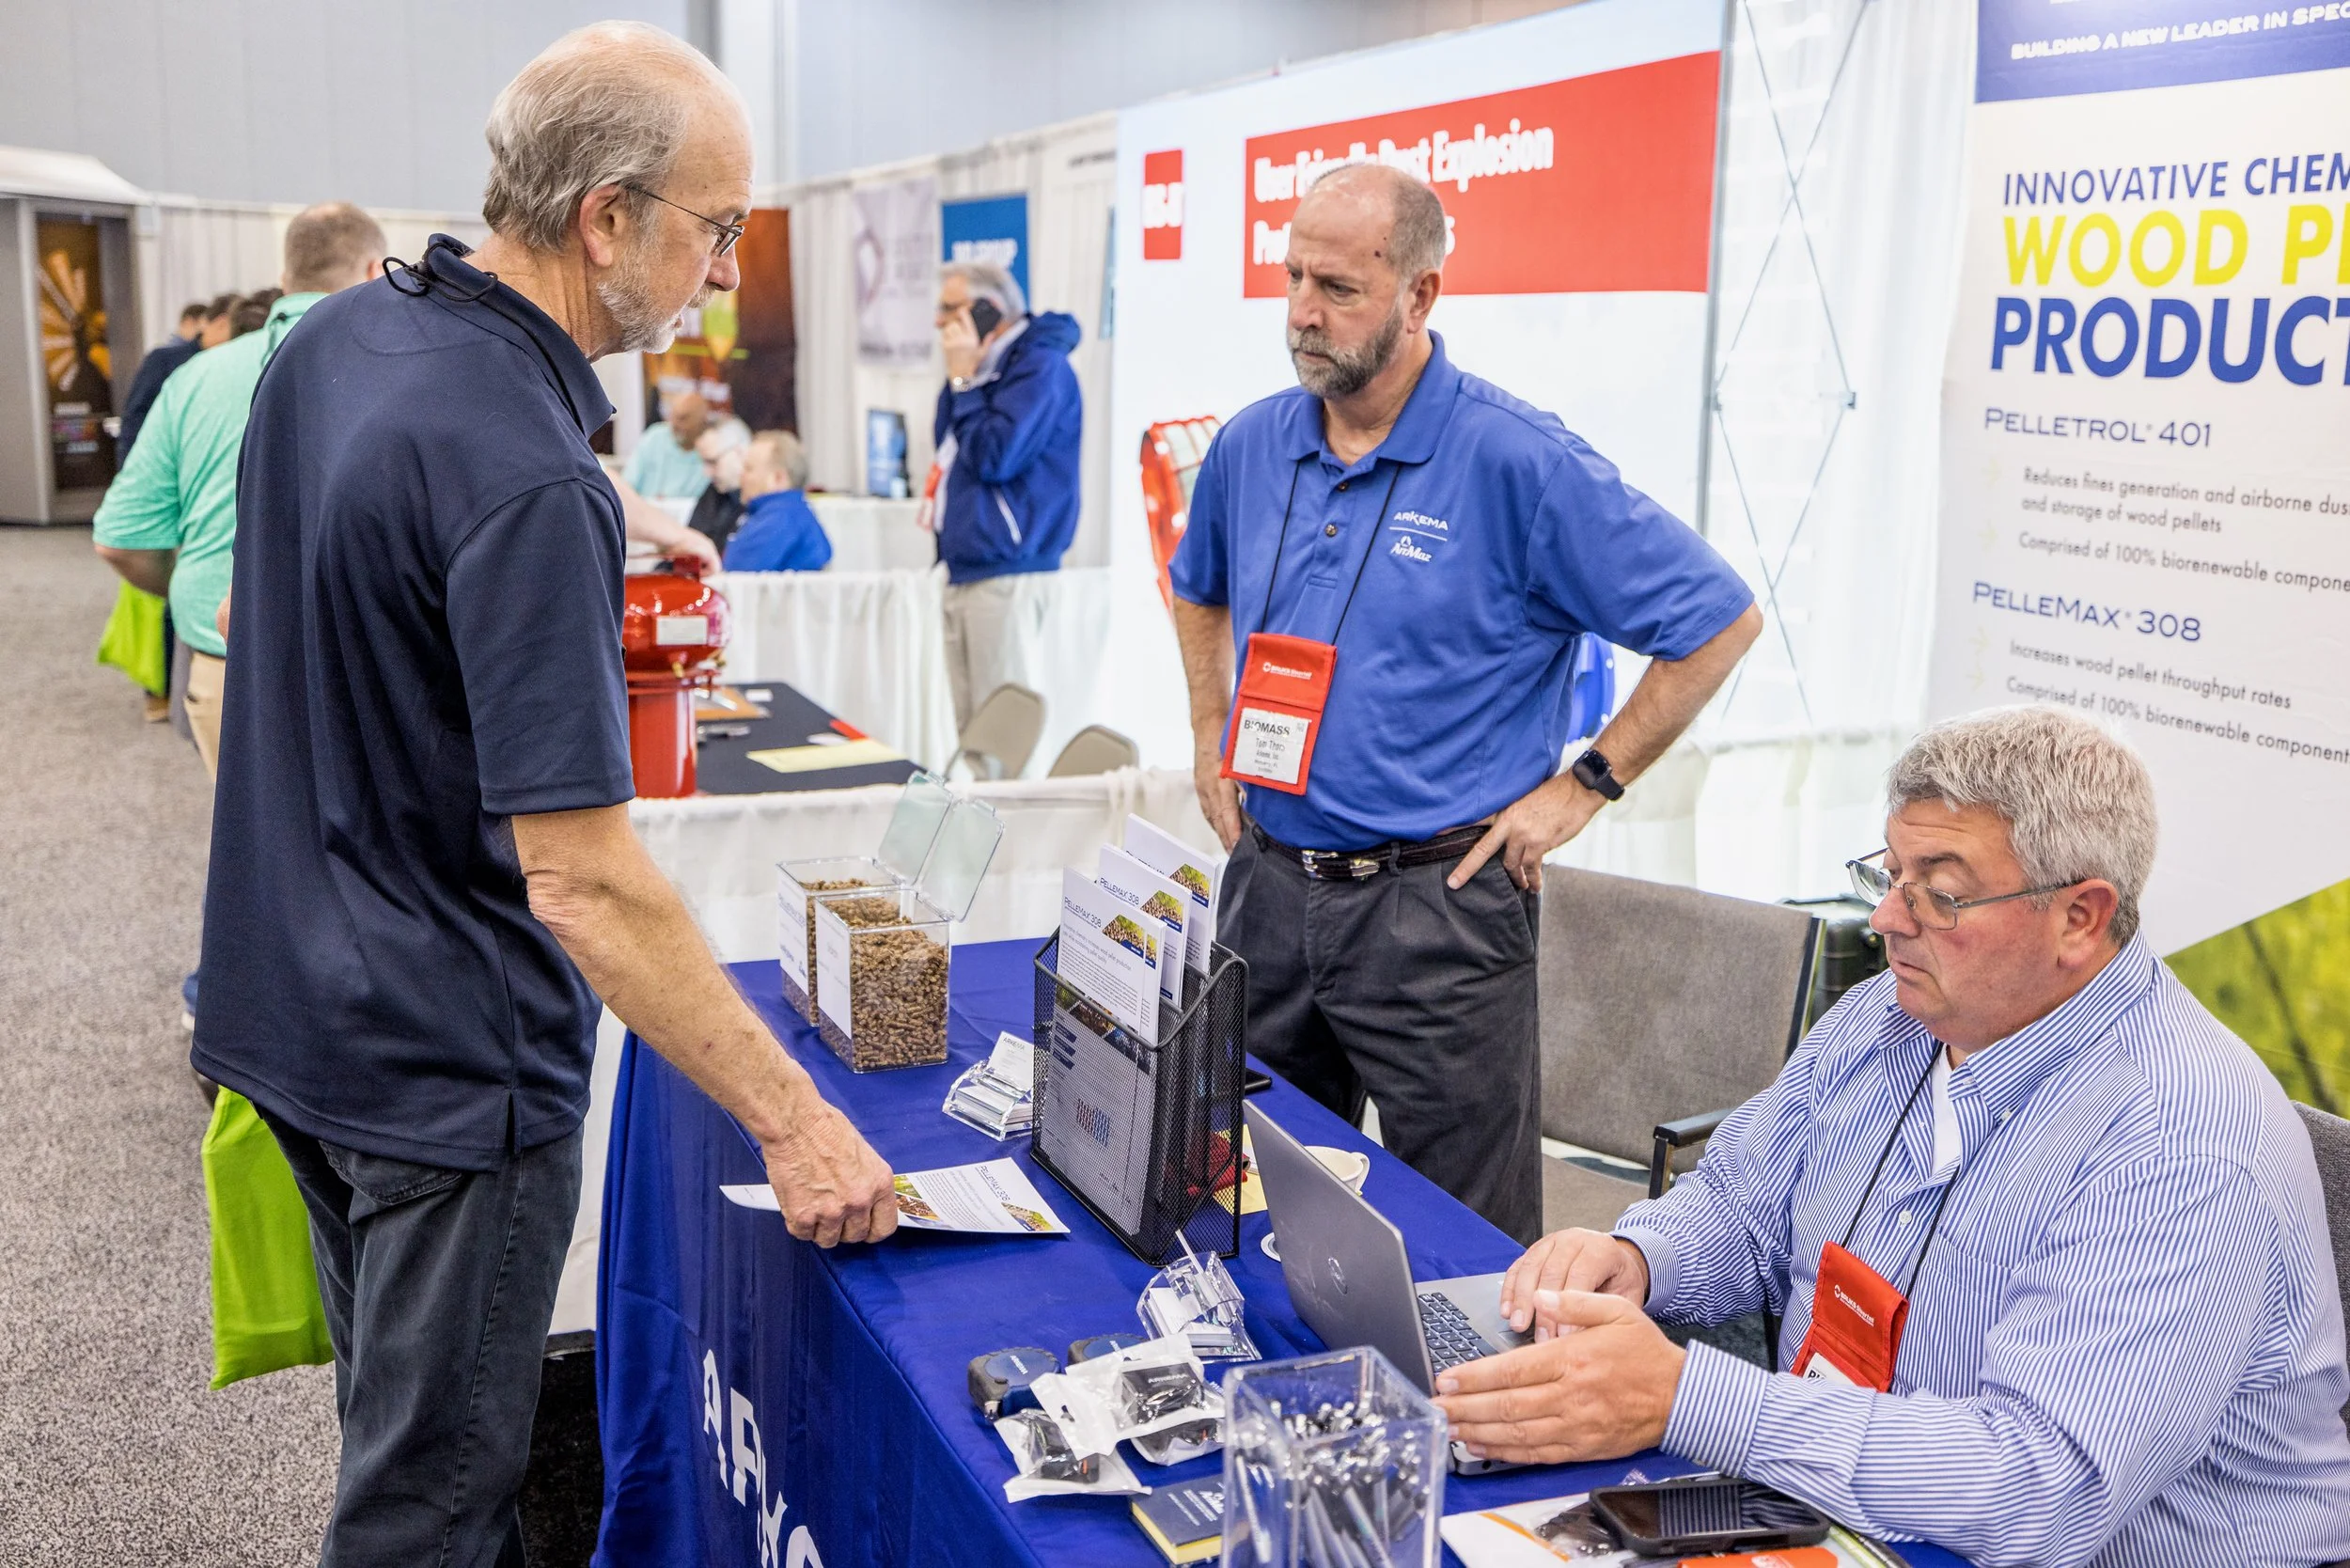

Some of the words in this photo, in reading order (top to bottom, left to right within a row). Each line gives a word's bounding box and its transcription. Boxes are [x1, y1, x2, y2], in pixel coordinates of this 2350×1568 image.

[2012, 35, 2101, 60] BUILDING
[2102, 33, 2119, 50] A
[2121, 26, 2169, 48] NEW
[2170, 14, 2260, 42] LEADER
[2264, 10, 2288, 30] IN
[1432, 118, 1554, 193] Explosion
[2003, 161, 2229, 206] INNOVATIVE
[2003, 209, 2248, 288] WOOD
[2158, 421, 2211, 447] 401
[2021, 494, 2047, 512] and
[2051, 500, 2102, 523] storage
[2107, 502, 2123, 521] of
[2126, 508, 2169, 526] wood
[2172, 511, 2222, 533] pellets
[2024, 466, 2078, 489] Reduces
[2082, 470, 2115, 492] fines
[2119, 480, 2200, 501] generation
[2204, 486, 2235, 504] and
[2241, 488, 2312, 512] airborne
[2319, 494, 2350, 515] dus
[1394, 510, 1449, 531] ARKEMA
[2019, 530, 2091, 557] Comprised
[2094, 541, 2110, 559] of
[2116, 544, 2156, 566] 100%
[2162, 550, 2268, 581] biorenewable
[2137, 610, 2201, 641] 308
[2010, 639, 2070, 666] Increases
[2075, 657, 2114, 675] wood
[2117, 662, 2157, 682] pellet
[2162, 668, 2247, 701] throughput
[2251, 690, 2292, 710] rates
[2007, 675, 2077, 706] Comprised
[2080, 693, 2096, 709] of
[2102, 695, 2140, 720] 100%
[2146, 704, 2250, 744] biorenewable
